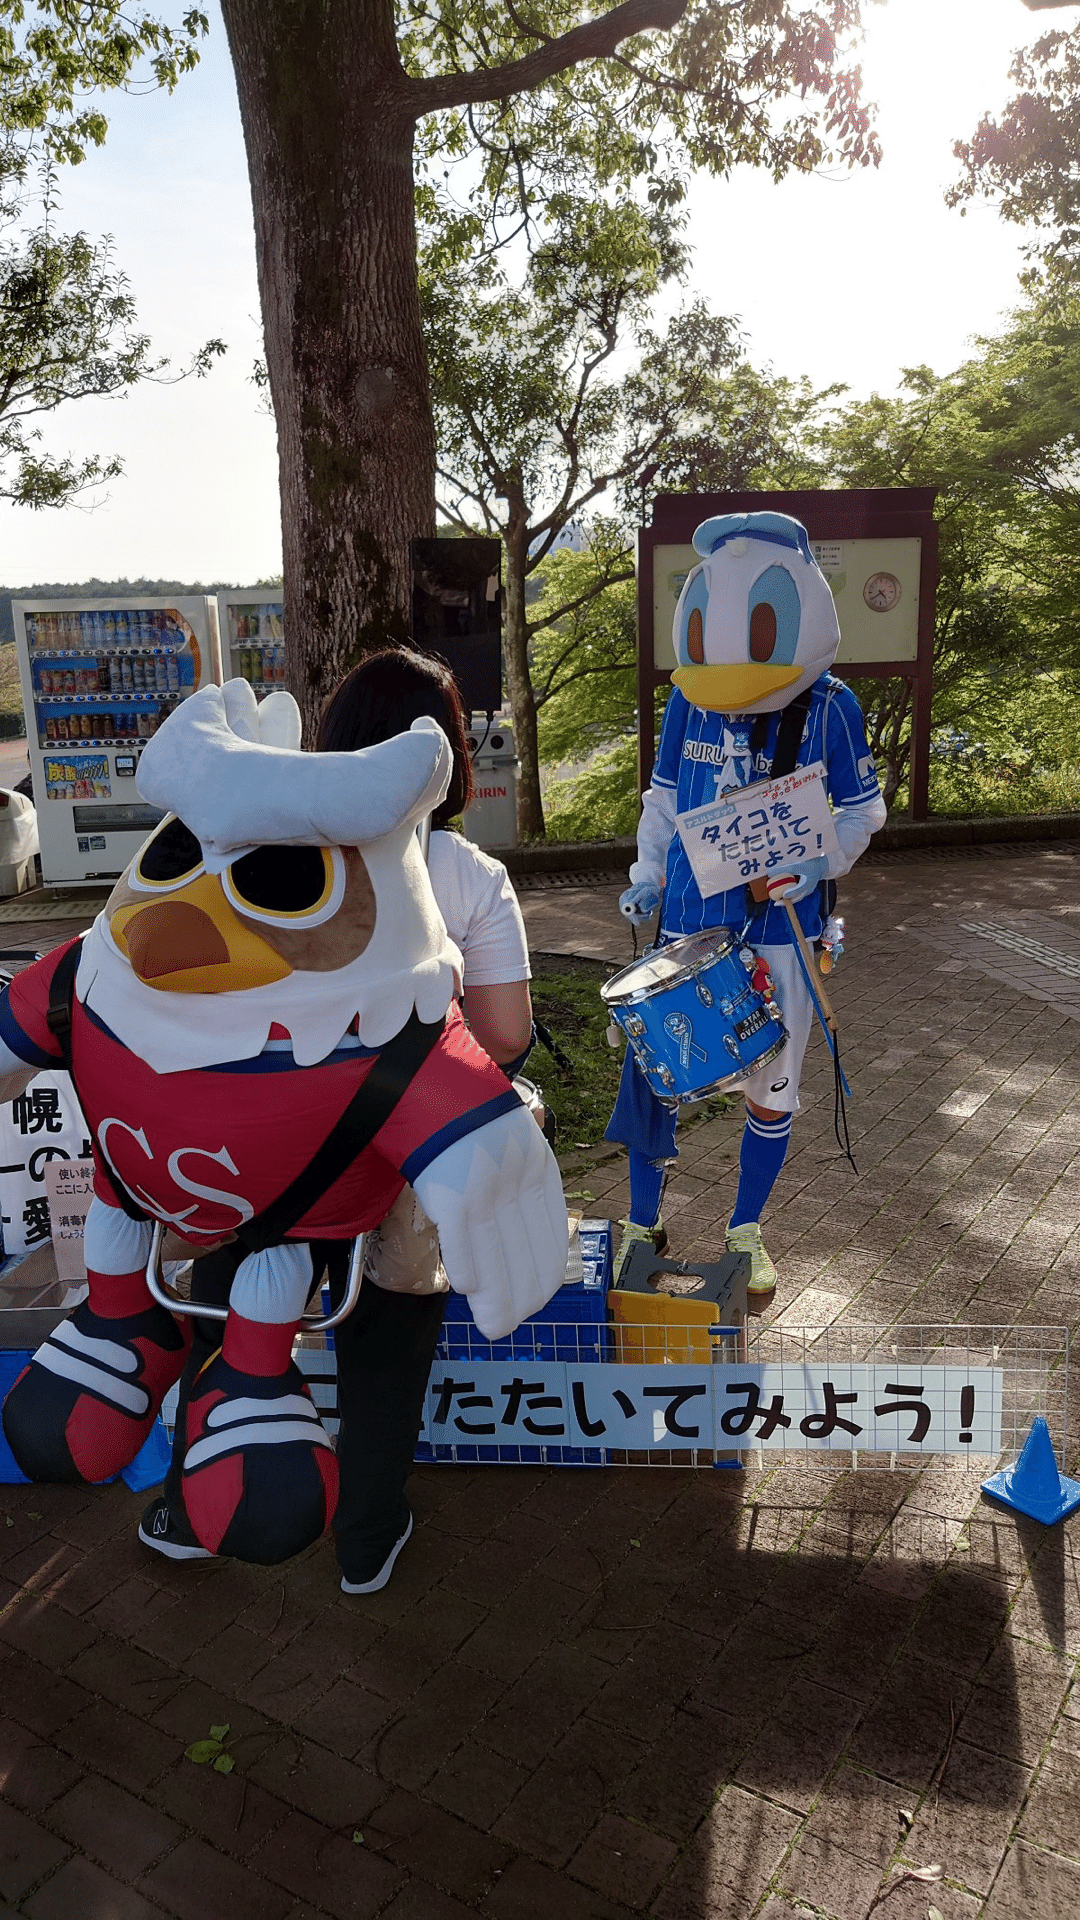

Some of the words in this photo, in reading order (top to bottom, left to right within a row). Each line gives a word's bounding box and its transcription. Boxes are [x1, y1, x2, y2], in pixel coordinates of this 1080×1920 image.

[701, 802, 792, 843] タイコを
[718, 816, 811, 862] たたいて
[738, 833, 822, 876] みよう！
[740, 1015, 769, 1040] OVERALL
[743, 1010, 760, 1027] STAR
[55, 1183, 94, 1195] ここに入
[419, 1377, 975, 1443] たたいてみよう！
